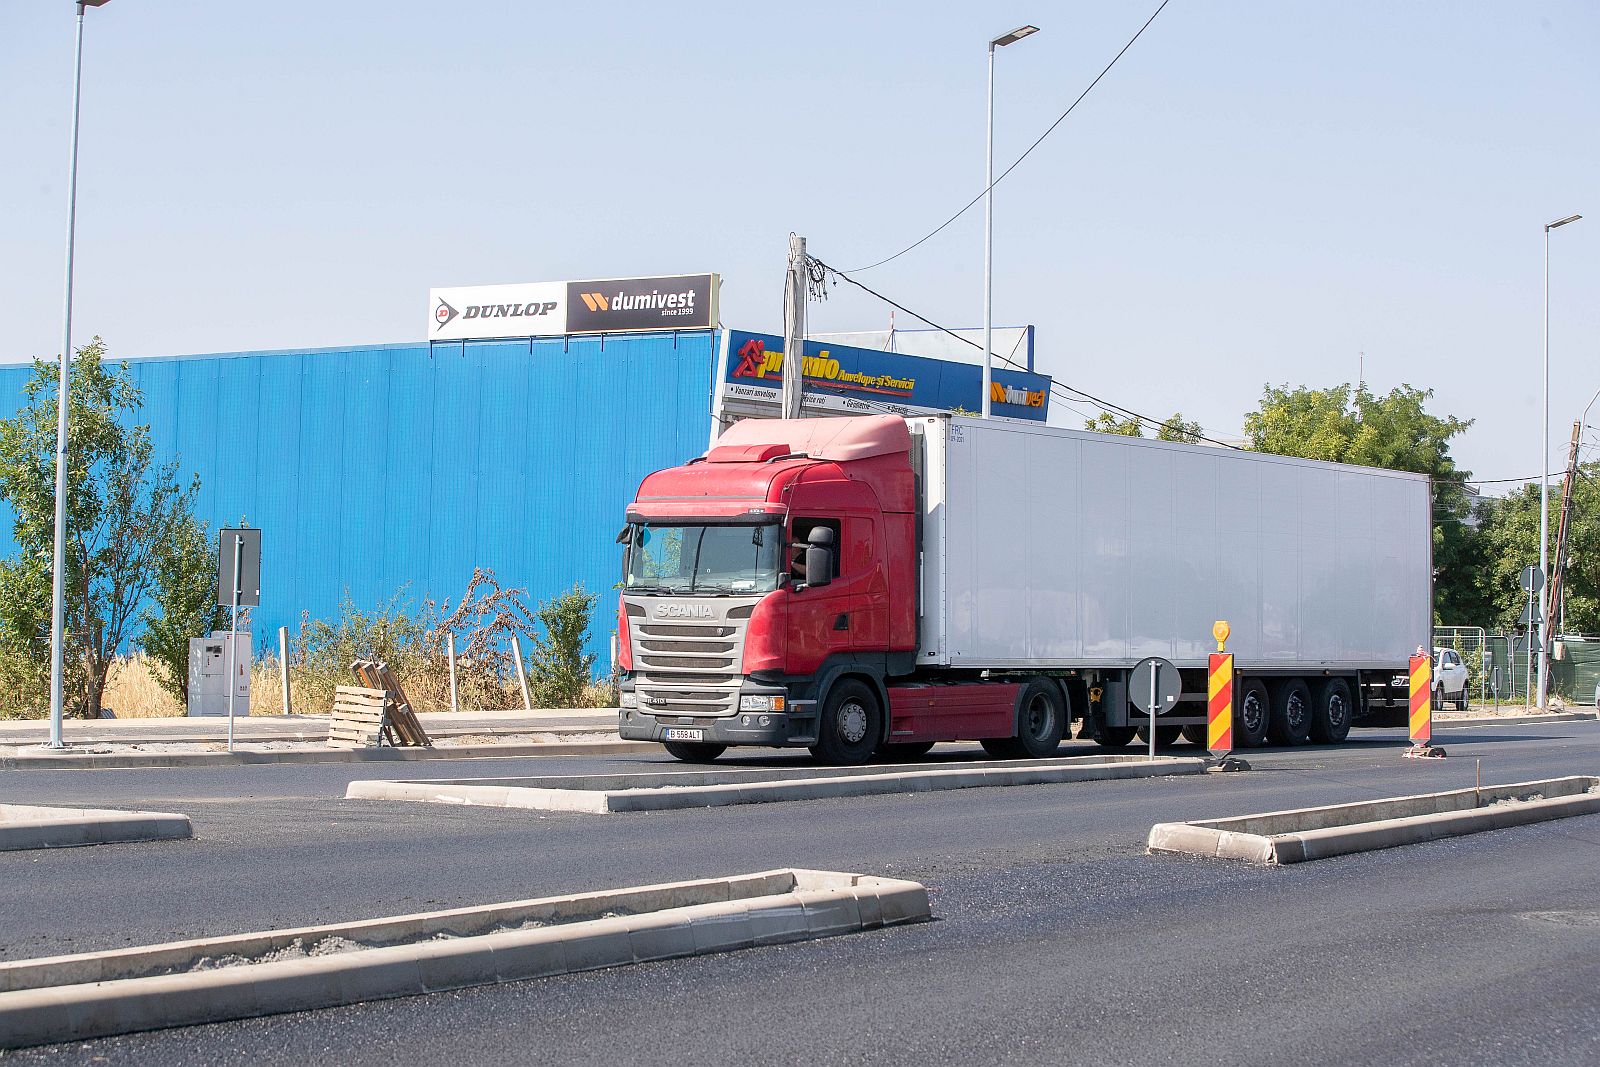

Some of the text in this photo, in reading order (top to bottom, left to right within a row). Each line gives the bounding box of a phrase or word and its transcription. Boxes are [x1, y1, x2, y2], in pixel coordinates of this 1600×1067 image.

[611, 289, 696, 311] dumivest
[463, 301, 558, 320] DUNLOP
[661, 307, 694, 316] since 1999
[757, 350, 840, 378] prmio
[838, 370, 876, 387] Anvelope
[885, 375, 916, 390] Servicii
[735, 386, 755, 396] Vanzari
[754, 389, 777, 400] anvelope
[951, 424, 964, 435] FRC
[656, 603, 715, 618] SCANIA
